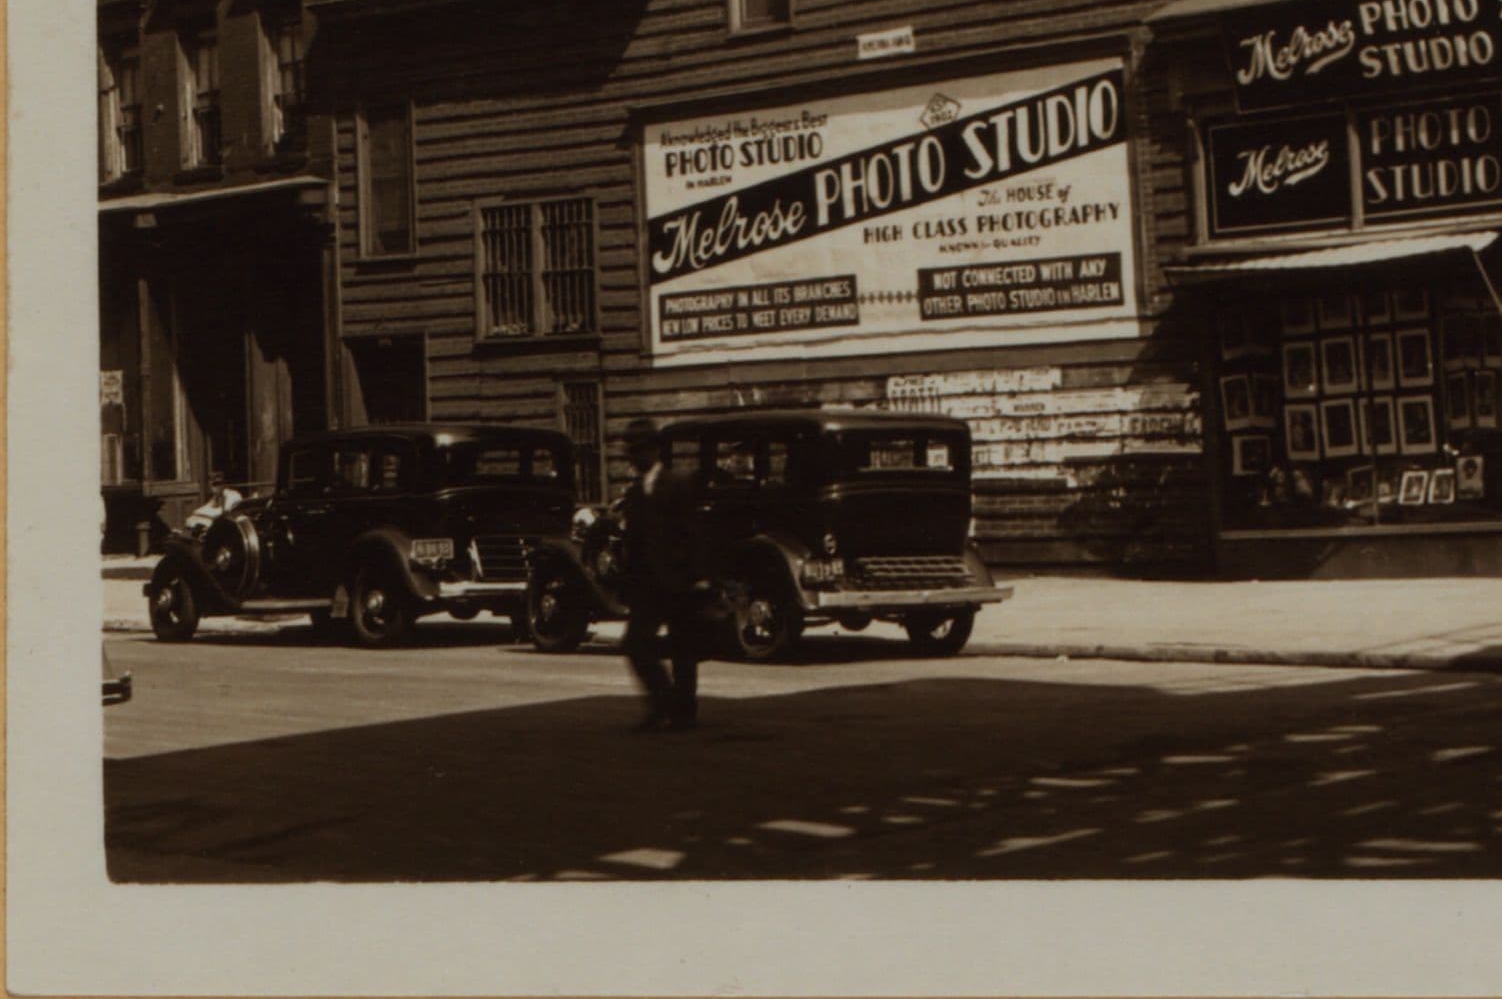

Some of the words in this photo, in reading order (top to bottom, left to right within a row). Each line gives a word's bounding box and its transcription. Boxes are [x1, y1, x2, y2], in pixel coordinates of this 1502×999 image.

[1237, 19, 1355, 84] Melrose
[1358, 30, 1494, 78] STUDIO
[1371, 105, 1491, 154] PHOTO
[652, 195, 807, 273] Melrose
[814, 135, 946, 227] PHOTO
[960, 79, 1118, 179] STUDIO
[665, 144, 735, 178] PHOTO
[740, 132, 823, 167] STUDIO
[1228, 139, 1329, 196] Melrose
[1006, 183, 1054, 203] HOUSE
[1058, 184, 1072, 203] of
[1366, 155, 1500, 203] STUDIO
[863, 225, 902, 244] HIGH
[912, 217, 968, 240] CLASS
[977, 202, 1120, 234] PHOTOGRAPHY
[665, 292, 734, 313] PHOTOGRAPHY
[737, 290, 749, 307] IN
[752, 288, 769, 306] ALL
[773, 285, 790, 303] ITS
[793, 280, 850, 302] BRANCHES
[933, 270, 959, 290] NOT
[962, 264, 1036, 288] CONNECTED
[1040, 260, 1072, 281] WITH
[1079, 258, 1107, 278] ANY
[662, 318, 680, 336] NEW
[702, 315, 733, 333] PRICES
[737, 313, 748, 329] TO
[752, 309, 776, 328] MEET
[779, 306, 811, 325] EVERY
[815, 304, 857, 322] DEMAND
[924, 295, 963, 315] OTHER
[967, 292, 1006, 314] PHOTO
[1009, 288, 1055, 310] STUDIO
[1071, 282, 1120, 303] HARLEM
